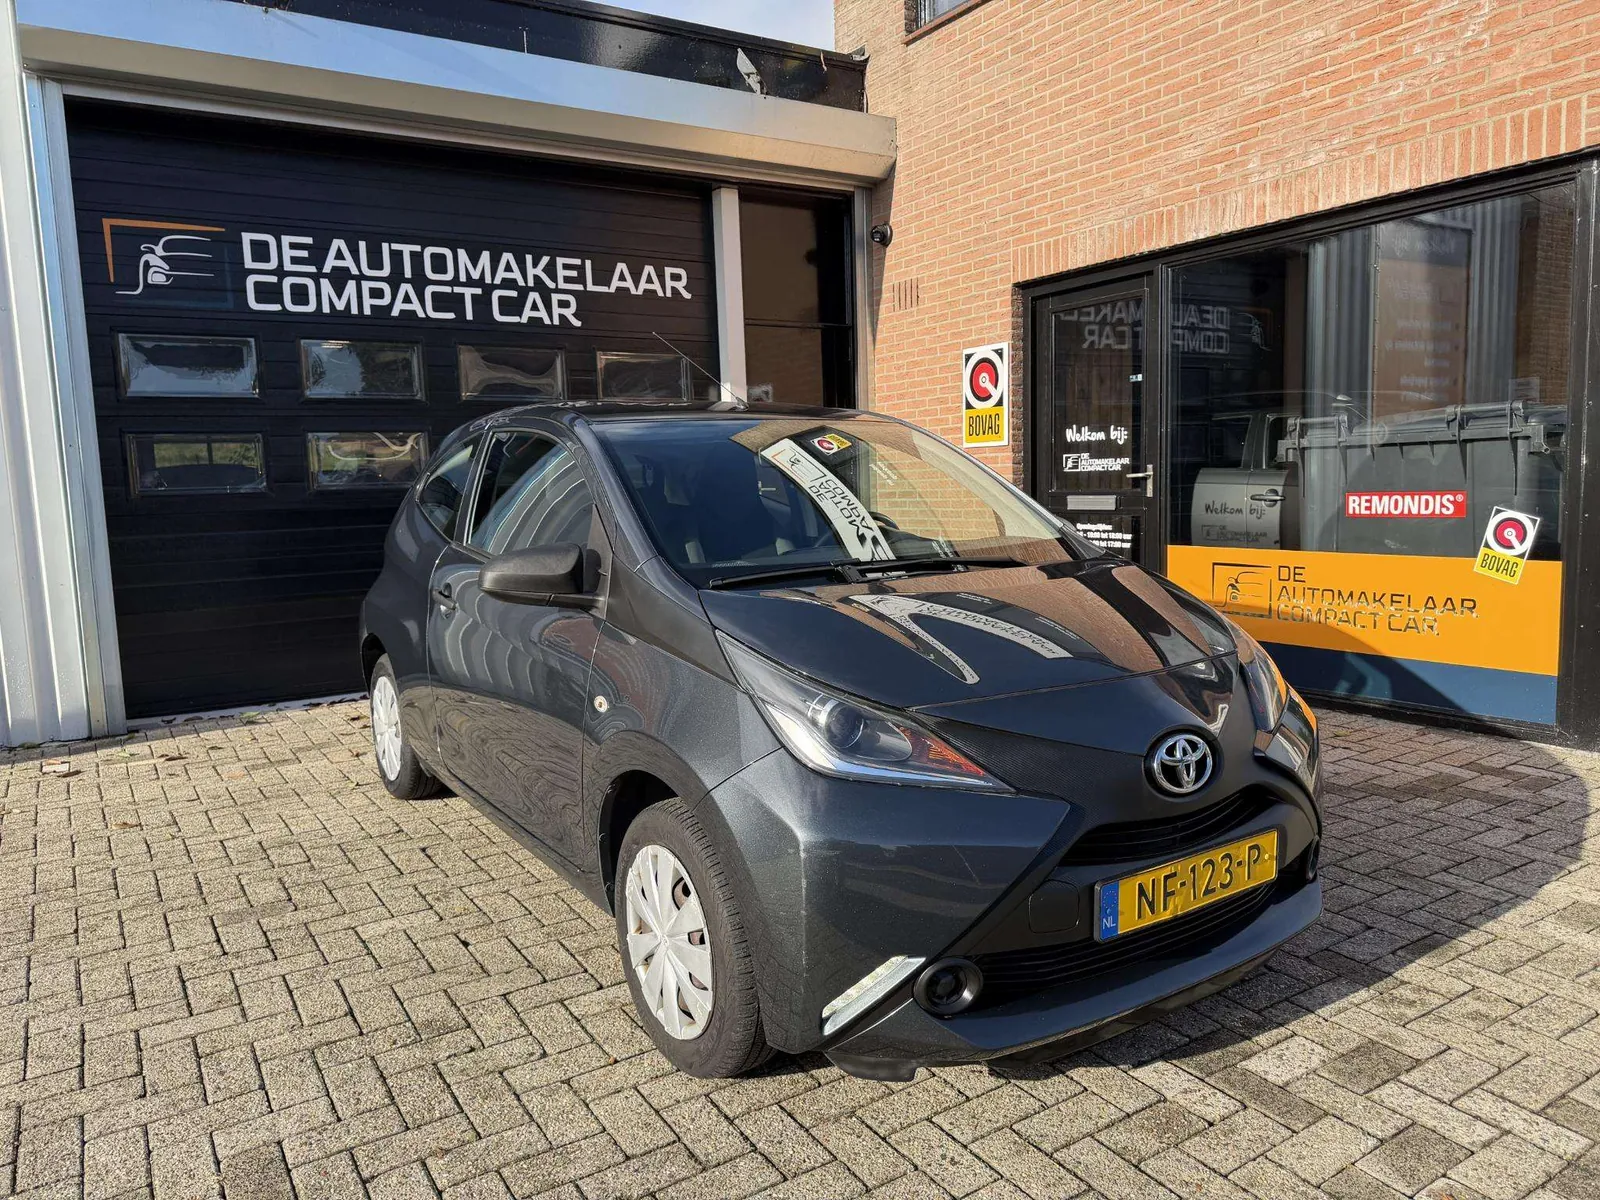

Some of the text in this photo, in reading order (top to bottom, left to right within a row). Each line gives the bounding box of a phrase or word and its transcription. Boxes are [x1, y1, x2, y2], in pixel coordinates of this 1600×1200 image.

[241, 231, 693, 300] DE AUTOMAKELAAR
[245, 274, 582, 328] COMPACT CAR
[968, 413, 1000, 436] BOVAG
[1065, 424, 1128, 445] Welkom bij:
[1108, 463, 1122, 471] CAR
[1205, 500, 1266, 519] Welkom bij:
[1277, 565, 1306, 583] DE
[1480, 552, 1519, 578] BOVAG
[1276, 585, 1480, 619] AUTOMAKELAAR
[1276, 604, 1441, 636] COMPACT CAR
[1135, 842, 1262, 921] NF-123-P
[1102, 917, 1116, 930] NL
